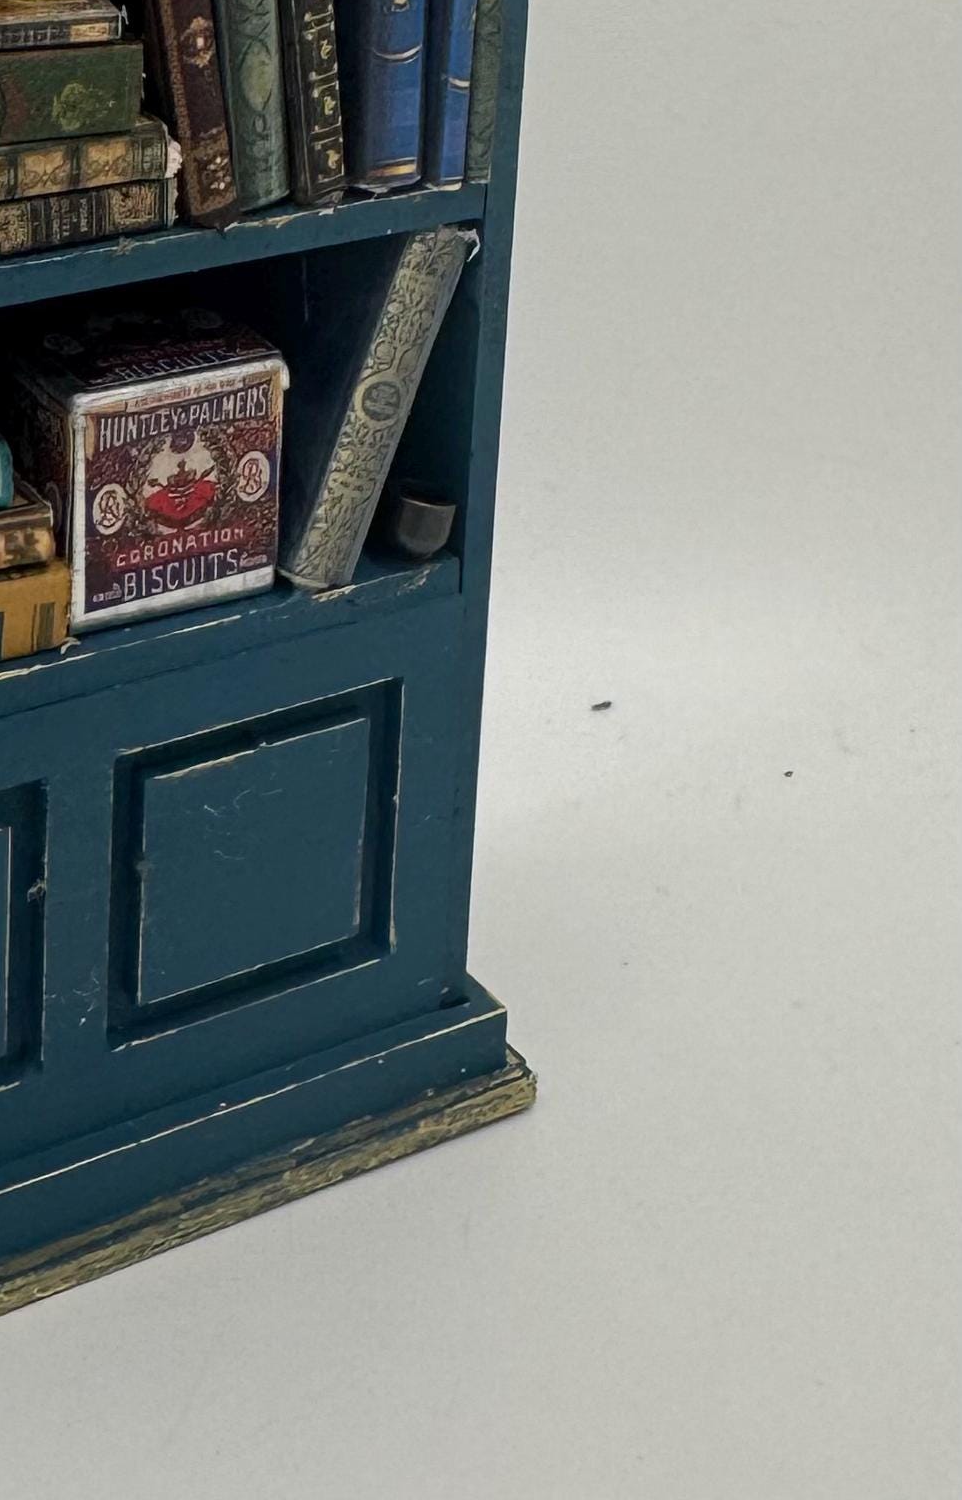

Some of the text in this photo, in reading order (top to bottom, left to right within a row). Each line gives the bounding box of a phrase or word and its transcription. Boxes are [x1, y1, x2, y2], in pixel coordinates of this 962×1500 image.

[99, 407, 182, 451] HUNTLEY
[188, 384, 269, 426] PALMERS
[116, 527, 245, 567] CORONATION
[124, 548, 239, 601] BISCUITS
